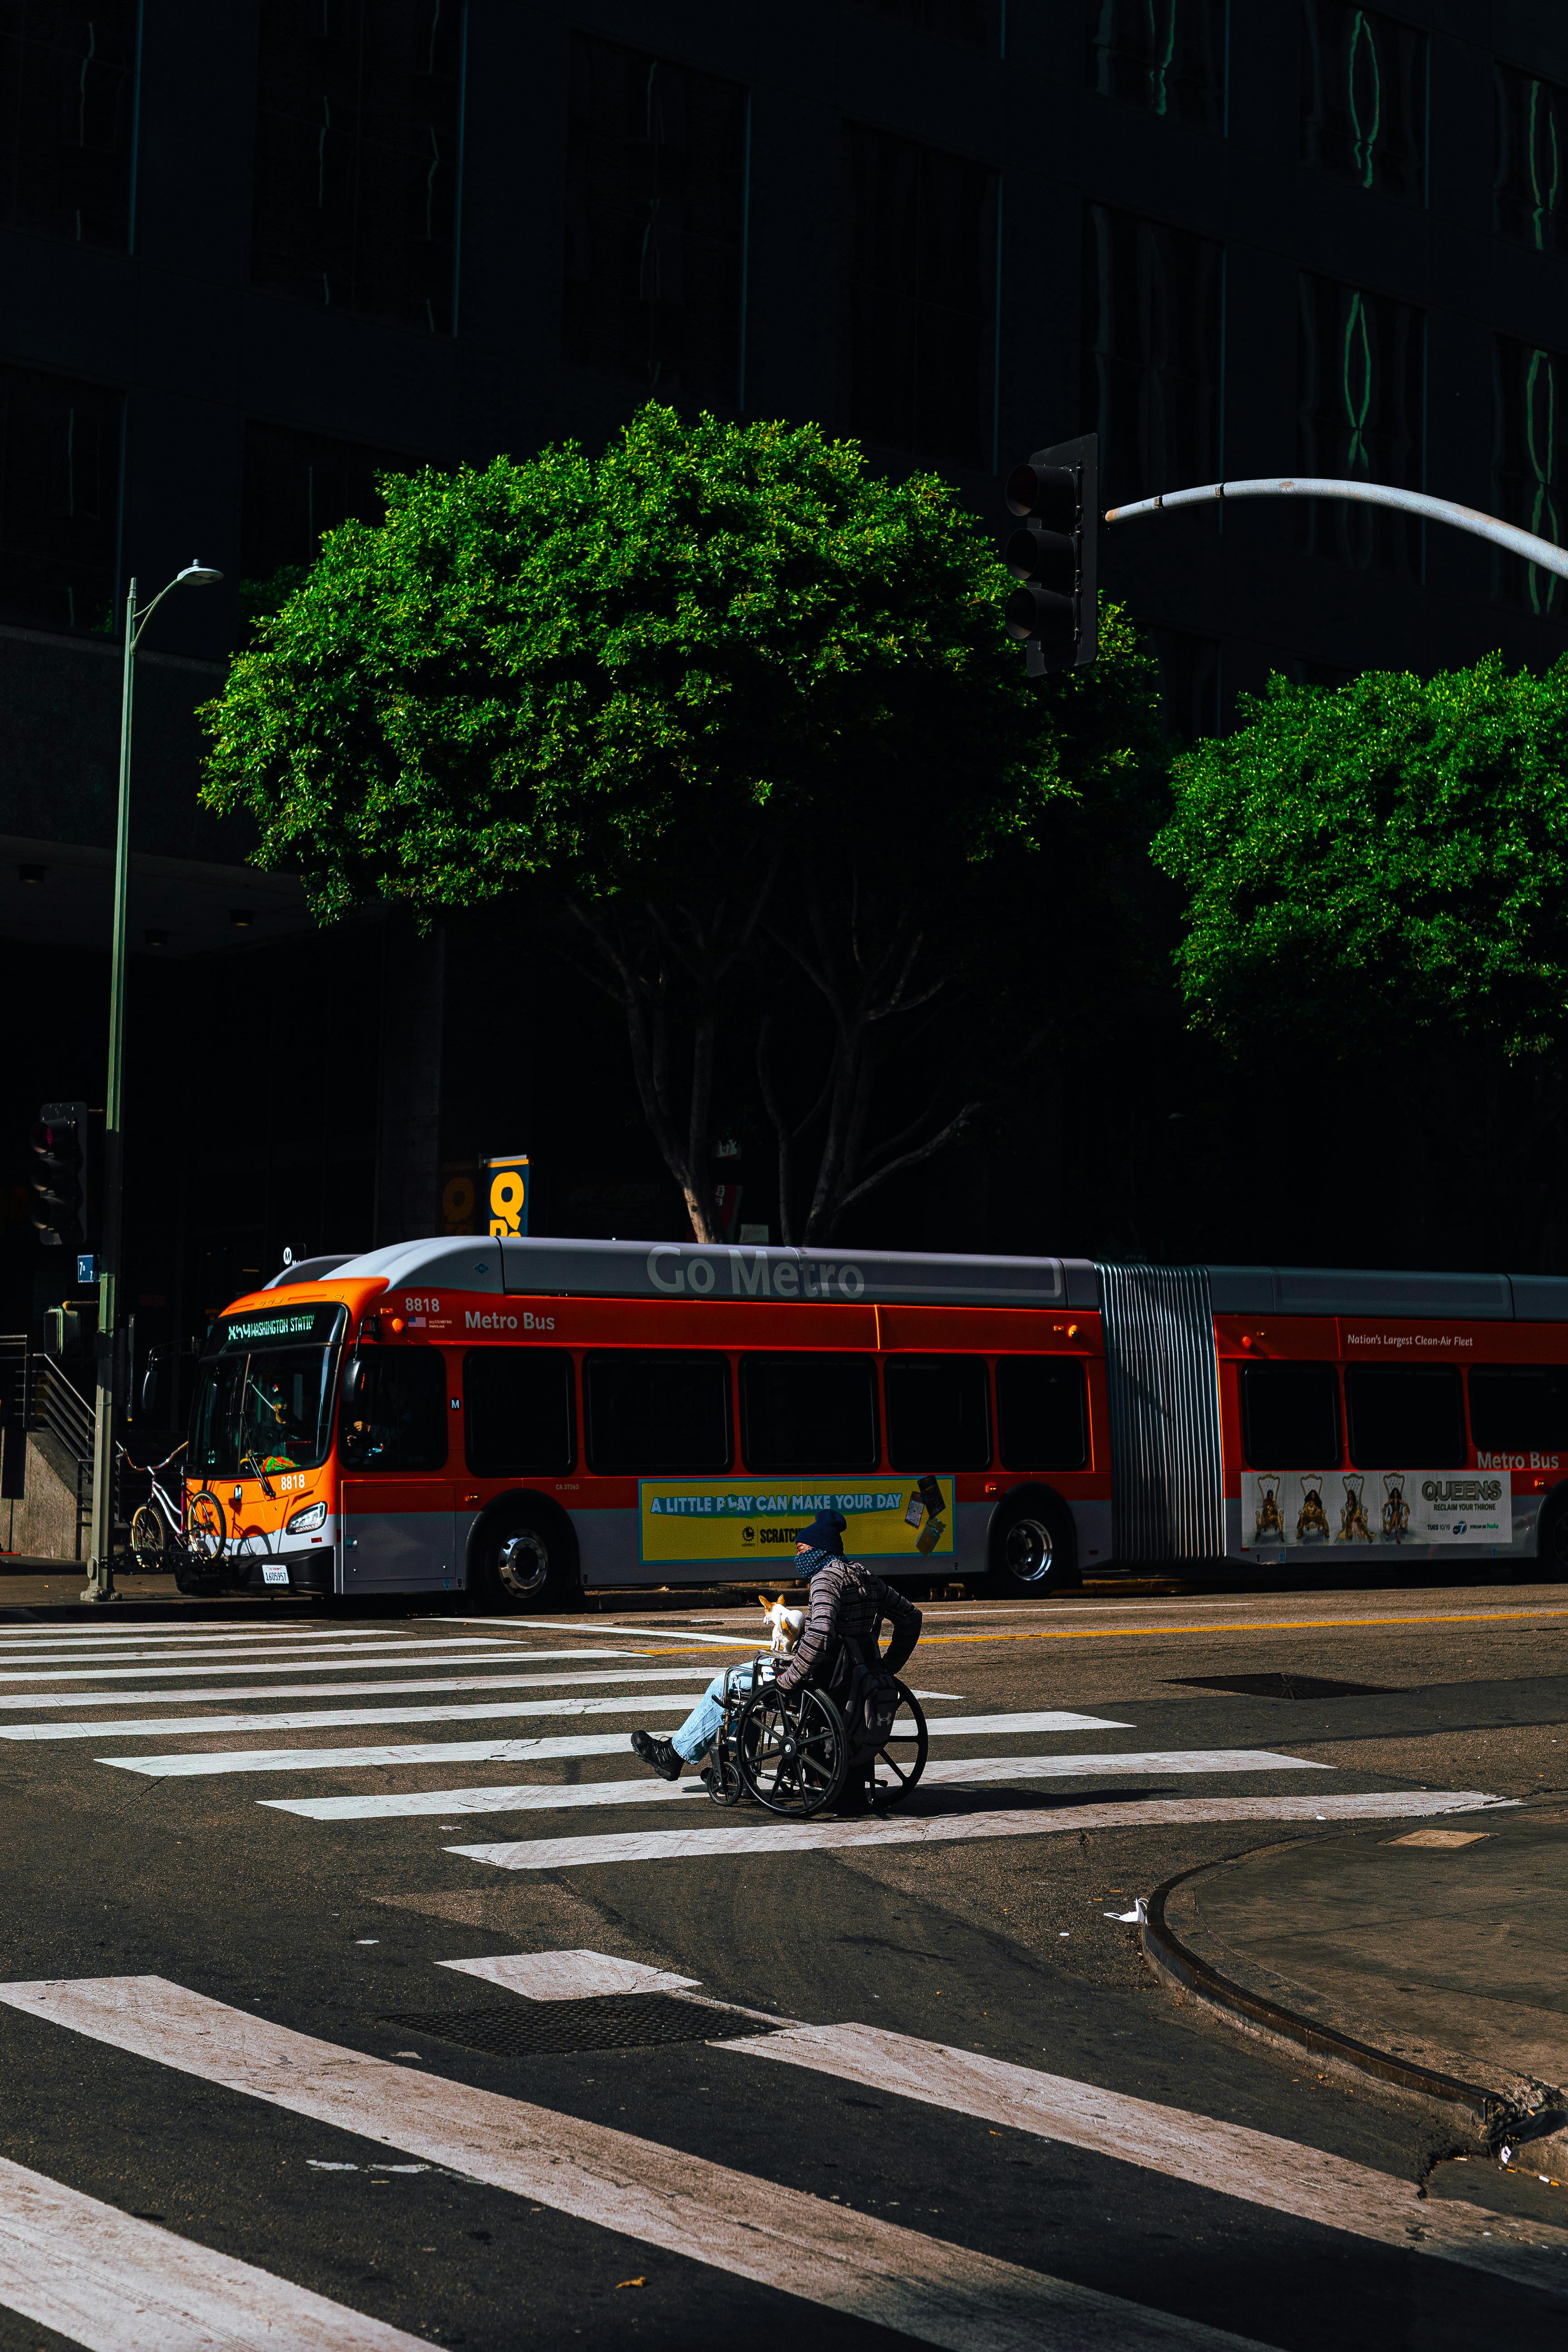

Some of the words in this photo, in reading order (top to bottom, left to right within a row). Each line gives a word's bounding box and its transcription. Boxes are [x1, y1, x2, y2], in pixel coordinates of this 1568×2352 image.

[647, 1245, 715, 1293] Go
[728, 1249, 864, 1298] Metro
[405, 1297, 440, 1313] 8818
[251, 1318, 289, 1337] WASHINGTON
[465, 1310, 518, 1329] Metro
[523, 1311, 555, 1330] Bus
[1347, 1333, 1381, 1345] Nation's
[1384, 1334, 1413, 1348] Largest
[1415, 1335, 1452, 1346] Clean-Air
[1454, 1336, 1473, 1347] Fleet
[1477, 1451, 1525, 1469] Metro
[1530, 1451, 1559, 1469] Bus
[281, 1474, 305, 1491] 8818
[1422, 1480, 1502, 1502] QUEENS
[651, 1497, 662, 1513] A
[666, 1497, 712, 1512] LITTLE
[717, 1496, 753, 1511] PLAY
[756, 1496, 787, 1511] CAN
[792, 1495, 831, 1510] MAKE
[834, 1494, 872, 1509] YOUR
[877, 1494, 902, 1509] DAY
[265, 1572, 286, 1581] 1605957
